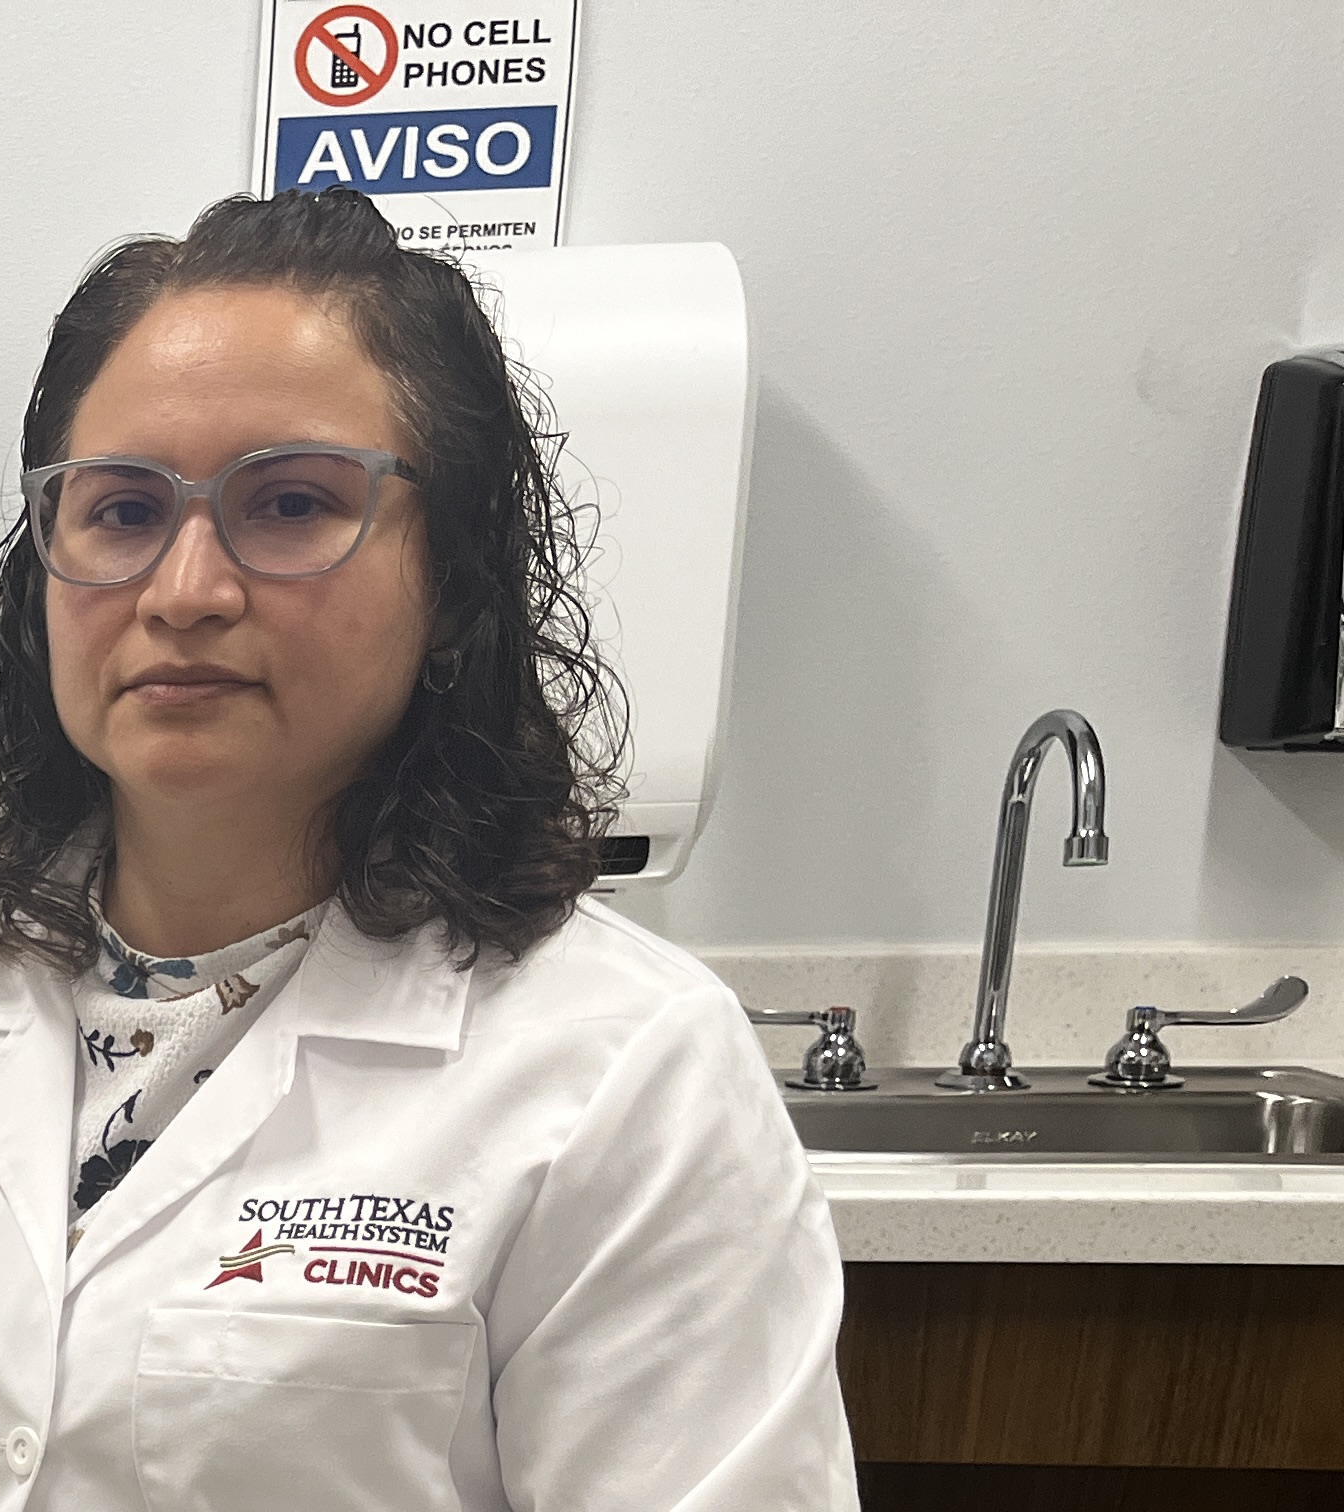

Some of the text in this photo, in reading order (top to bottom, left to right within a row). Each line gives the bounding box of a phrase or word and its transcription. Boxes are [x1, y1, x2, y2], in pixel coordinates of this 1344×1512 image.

[403, 19, 552, 50] NO CELL
[403, 57, 547, 89] PHONES
[296, 120, 532, 185] AVISO
[419, 225, 442, 240] SE
[447, 222, 537, 239] PERMITEN
[238, 1193, 455, 1232] SOUTH TEXAS
[274, 1223, 451, 1254] HEALTH SYSTEM
[303, 1258, 441, 1298] CLINICS
